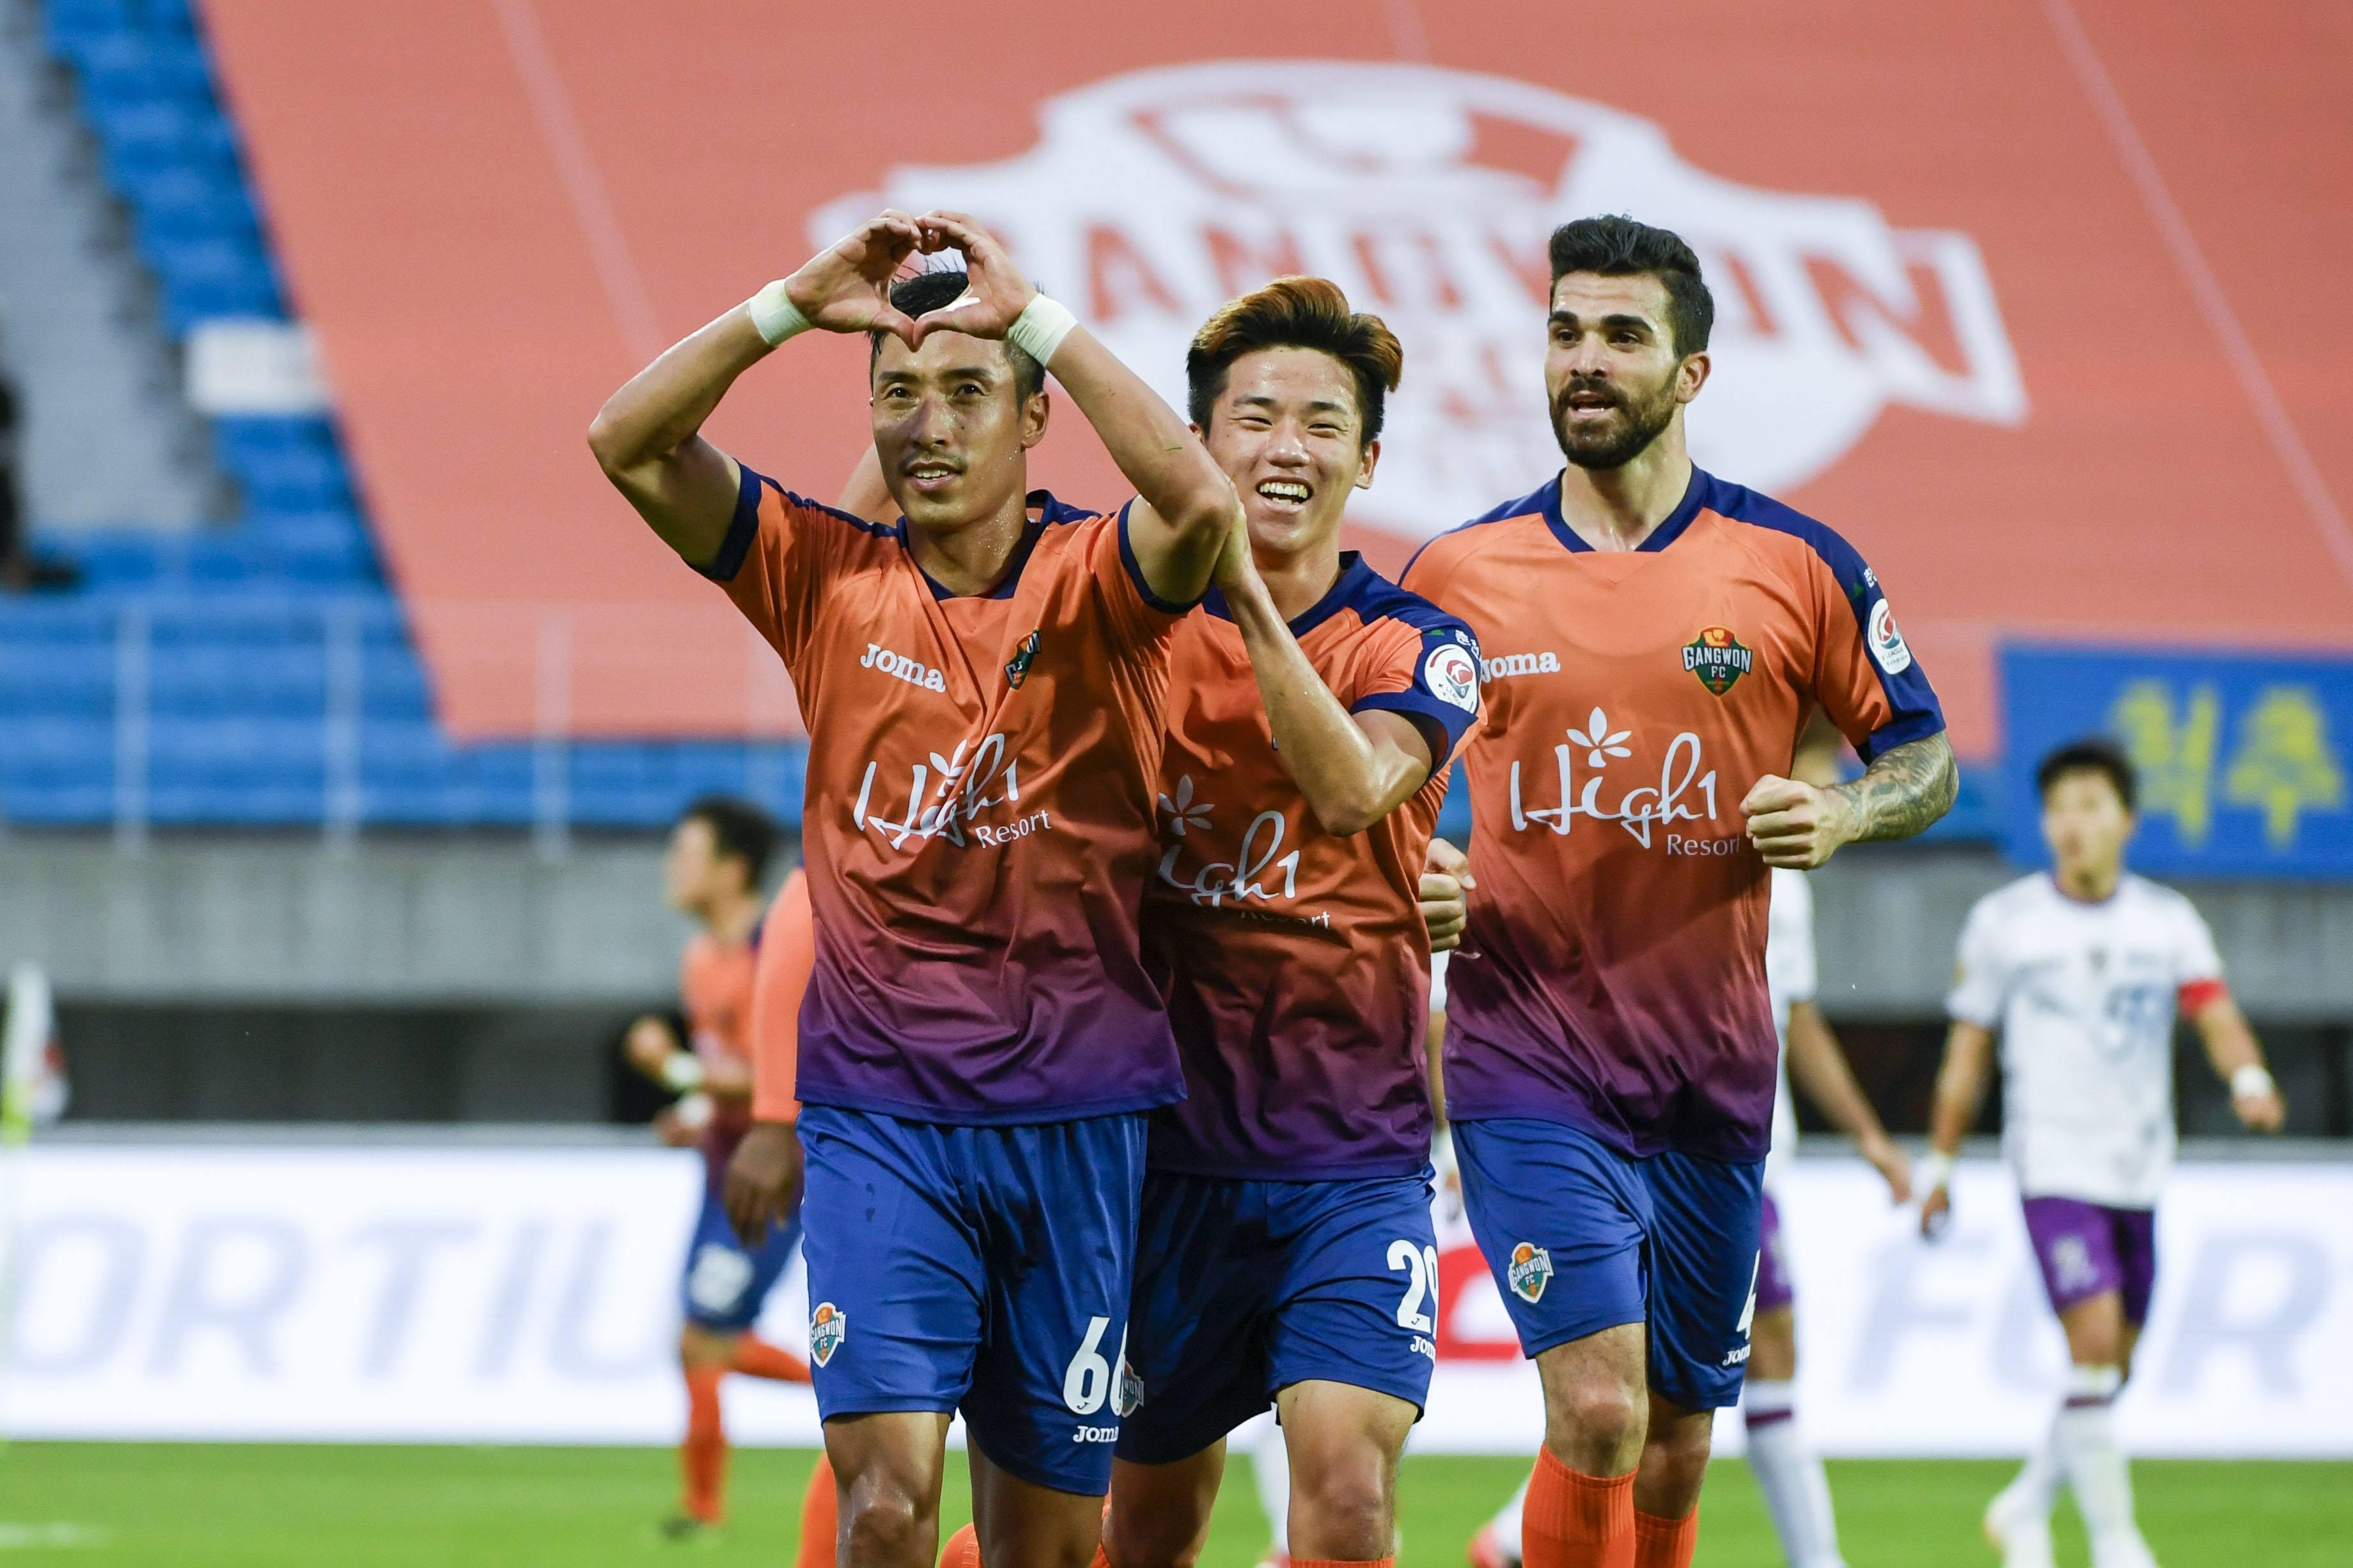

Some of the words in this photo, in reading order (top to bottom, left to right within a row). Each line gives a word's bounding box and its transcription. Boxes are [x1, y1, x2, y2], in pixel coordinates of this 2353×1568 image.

[860, 643, 946, 694] Joma
[1682, 646, 1752, 673] GANGWON
[1711, 665, 1726, 678] FC
[1510, 732, 1717, 849] High1
[975, 809, 1052, 848] Resort
[1158, 809, 1300, 909] igh1
[1512, 1254, 1550, 1288] GANGWON
[1525, 1274, 1535, 1286] FC
[810, 1316, 843, 1349] GANGWON
[1410, 1335, 1436, 1363] Jom
[1722, 1344, 1751, 1366] Jom
[1072, 1425, 1119, 1443] Jom
